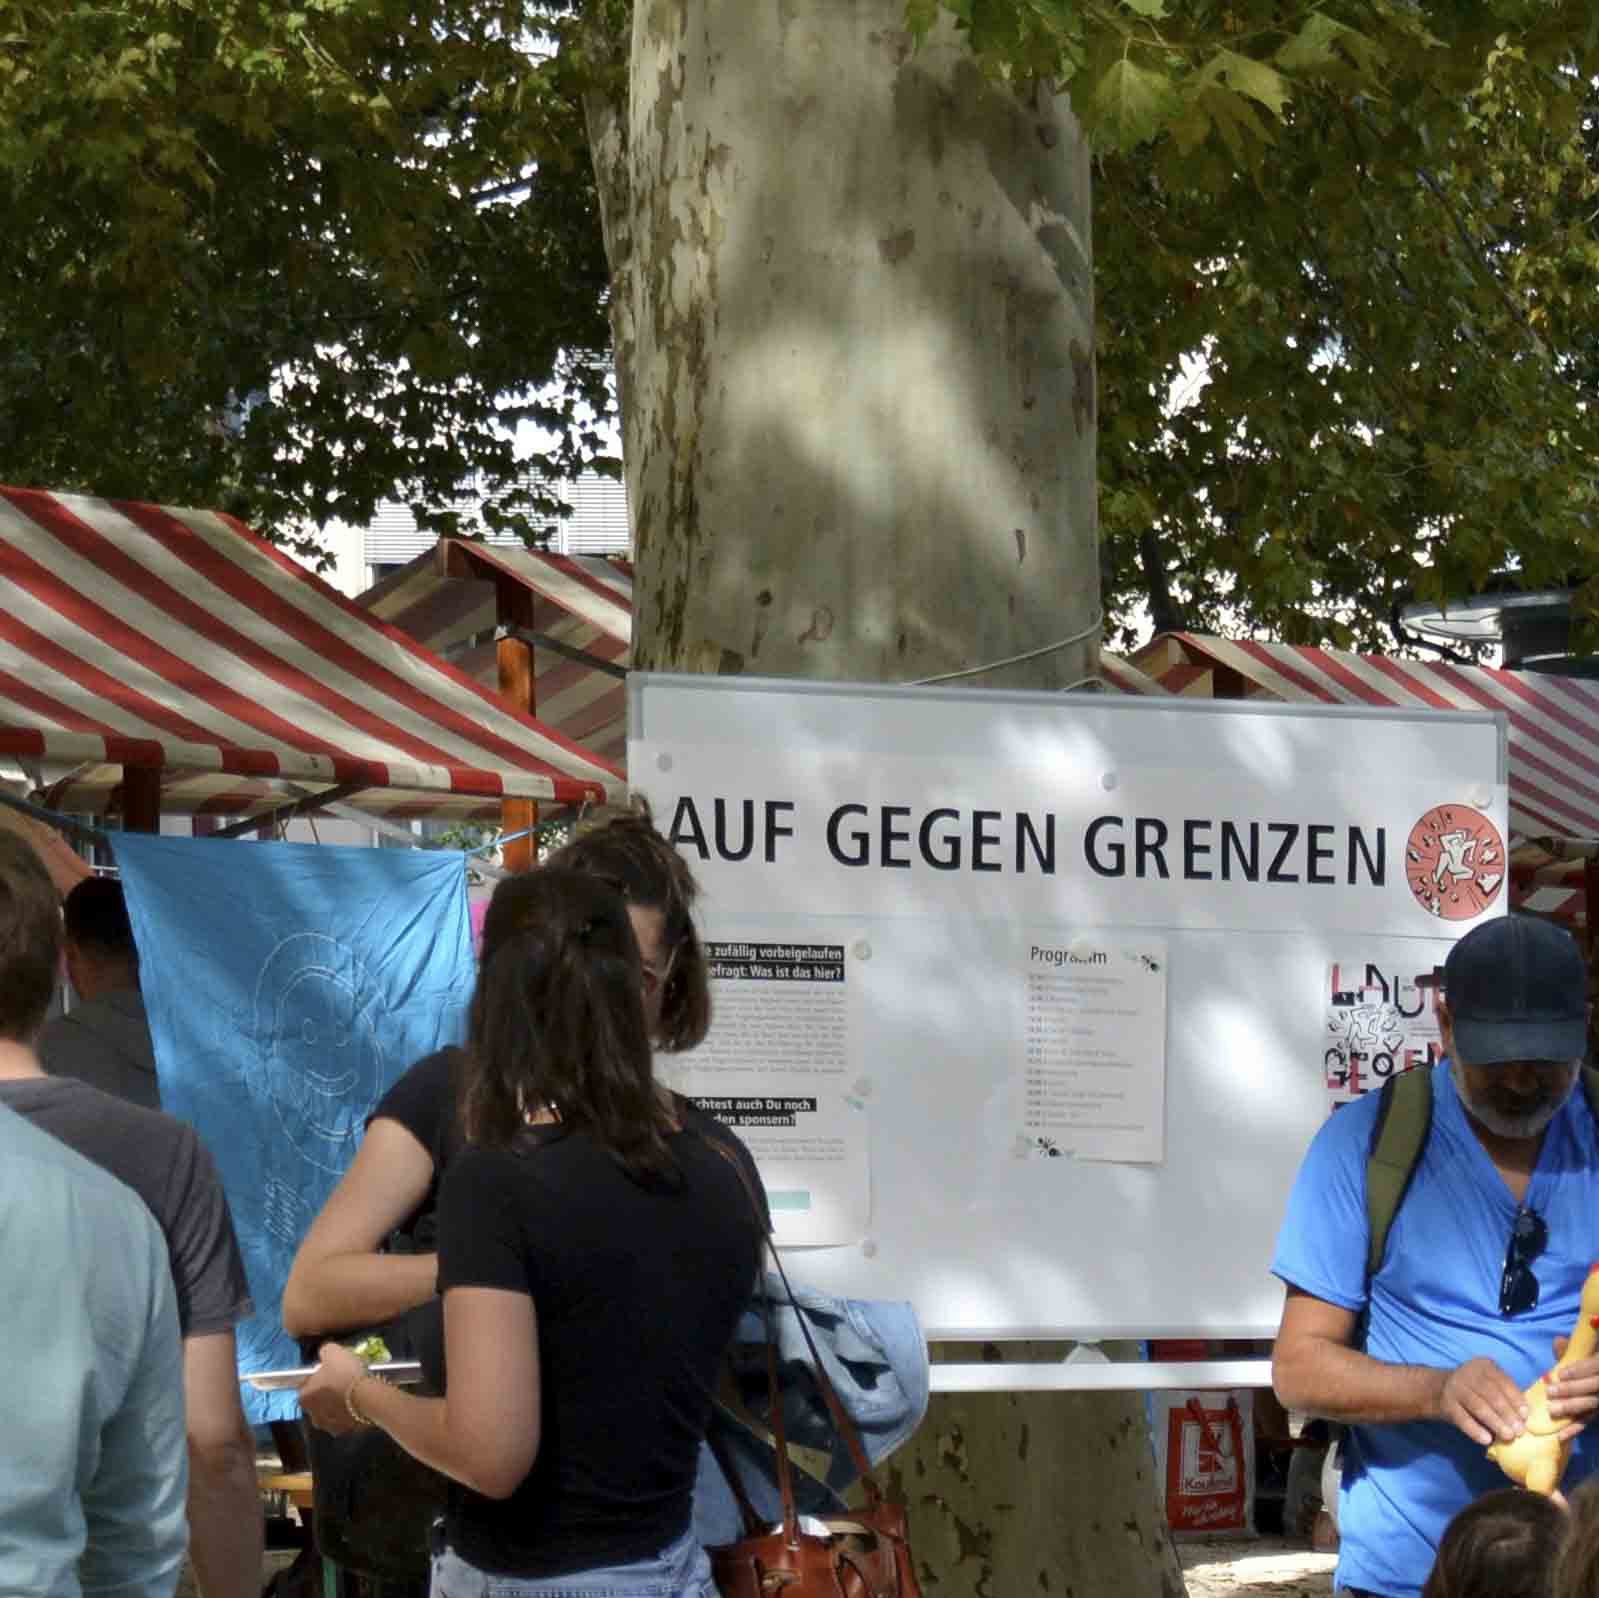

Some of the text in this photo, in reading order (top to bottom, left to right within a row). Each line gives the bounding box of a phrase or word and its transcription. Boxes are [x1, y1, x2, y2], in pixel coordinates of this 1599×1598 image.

[668, 796, 1386, 887] AUF GEGEN GRENZEN
[714, 943, 757, 961] zufällig
[759, 946, 842, 962] vorbeigelaufen
[1031, 946, 1107, 966] Progrm
[709, 964, 841, 979] efragt: Was ist das hier?
[695, 1098, 811, 1111] chtest auch Du noch
[739, 1114, 797, 1127] sponsern?
